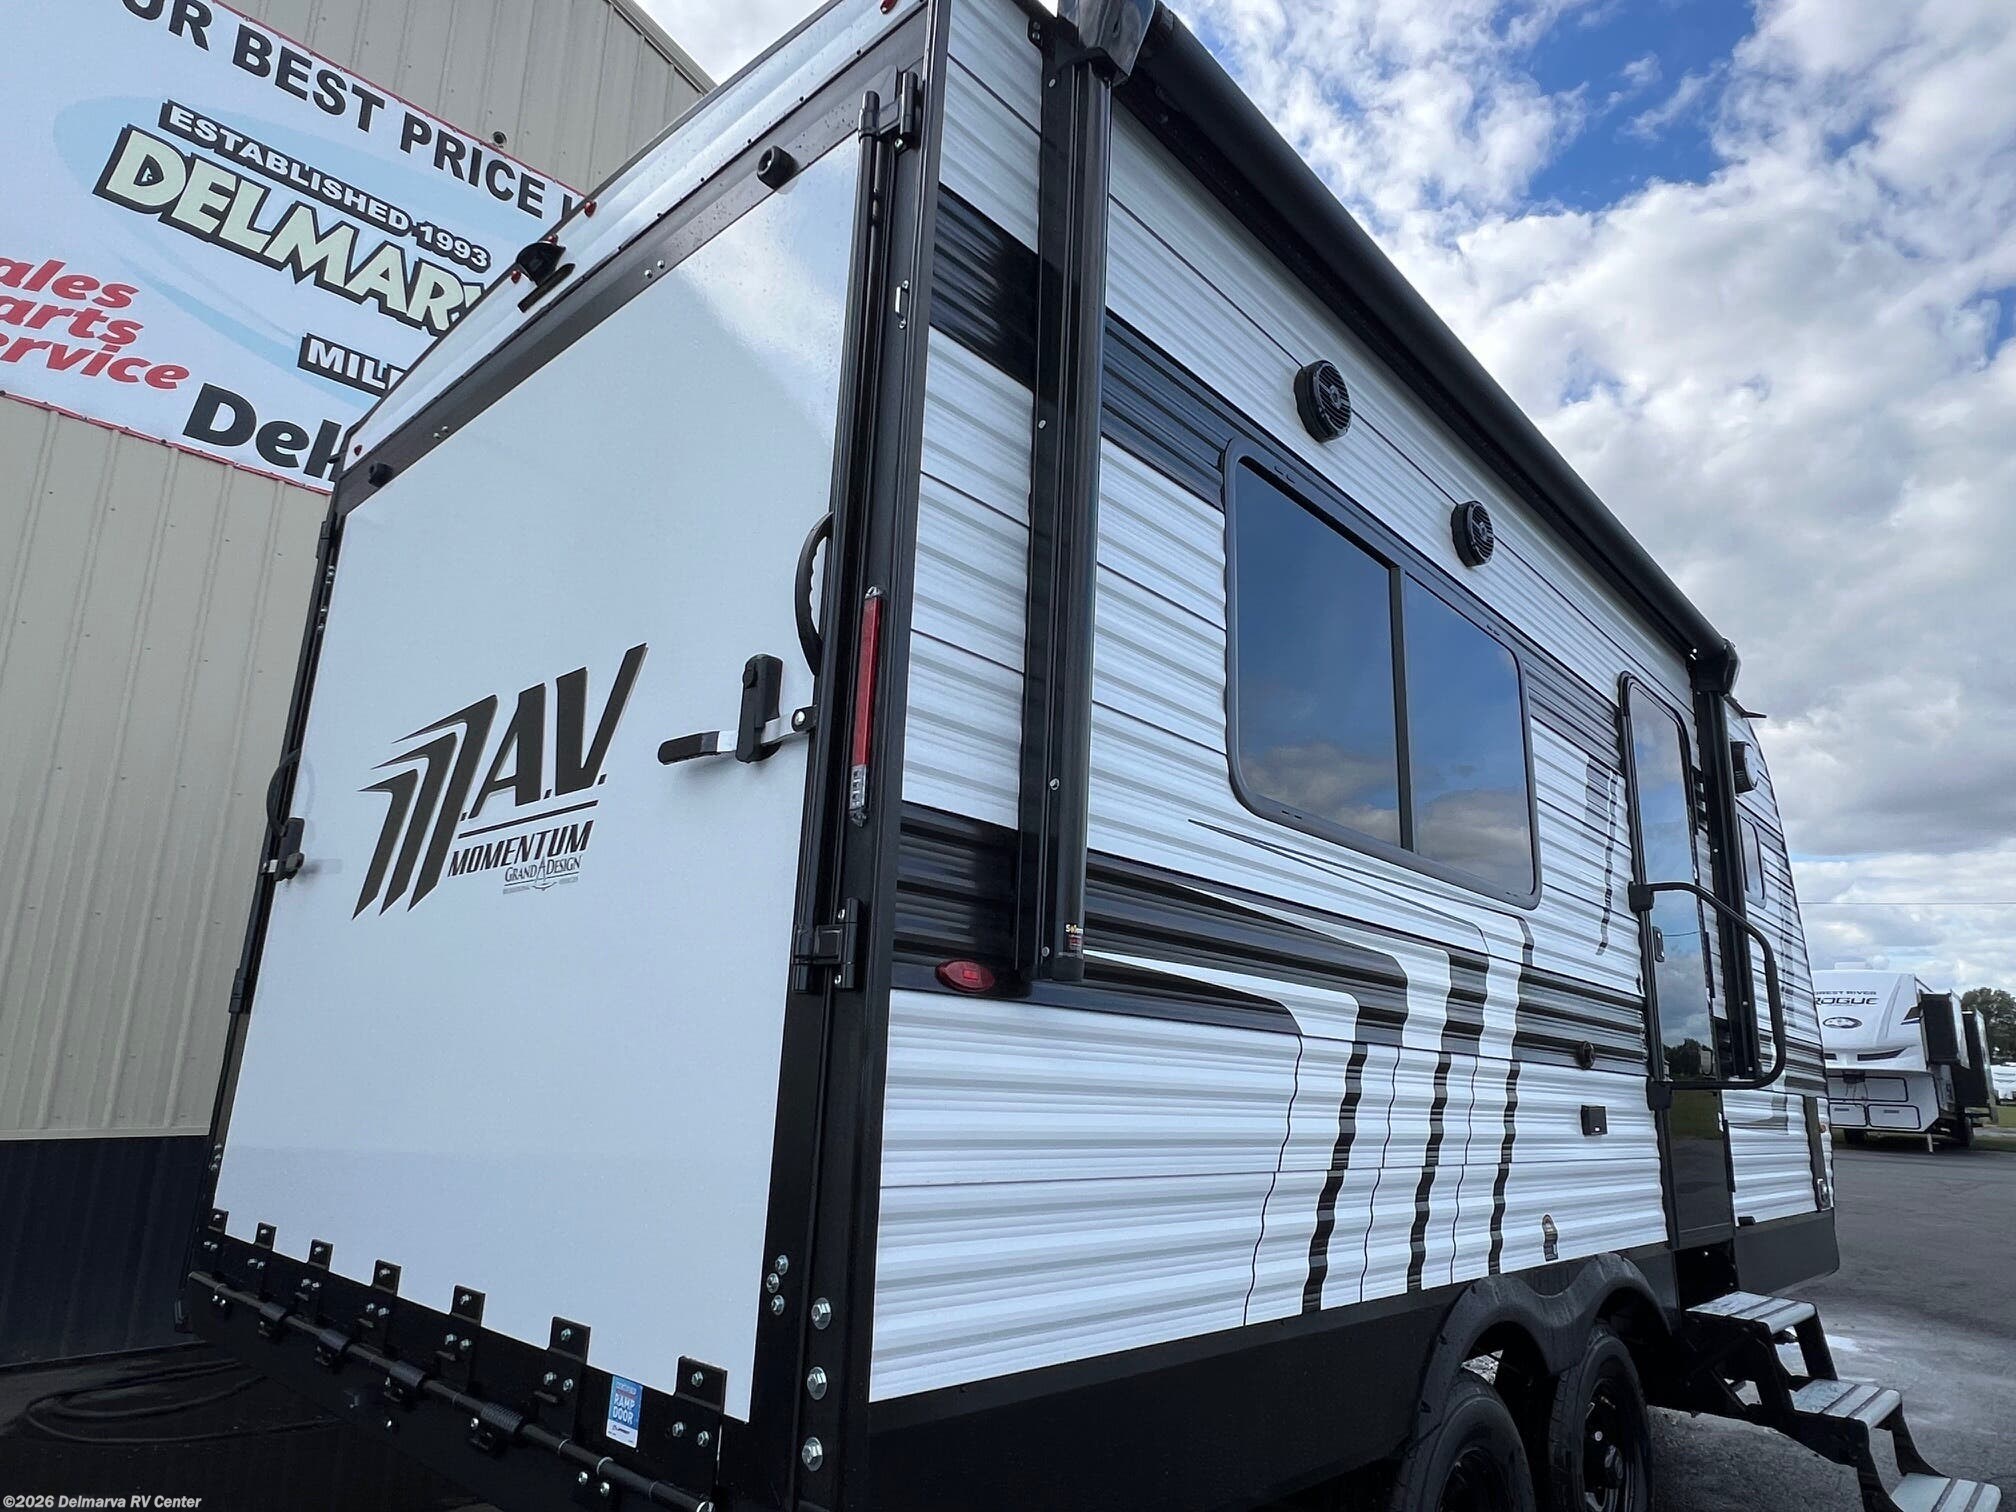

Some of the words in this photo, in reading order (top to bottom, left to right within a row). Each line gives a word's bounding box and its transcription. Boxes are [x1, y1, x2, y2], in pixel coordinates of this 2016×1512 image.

[232, 23, 385, 133] BEST
[400, 111, 546, 219] PRICE
[164, 102, 411, 232] ESTABLISHED
[417, 223, 489, 270] 1993
[0, 332, 190, 390] rvice
[183, 382, 342, 482] Del
[447, 819, 594, 878] MOMENTUM
[504, 864, 538, 883] GRAND
[546, 855, 583, 876] DESIGN
[612, 1406, 634, 1425] DOOR
